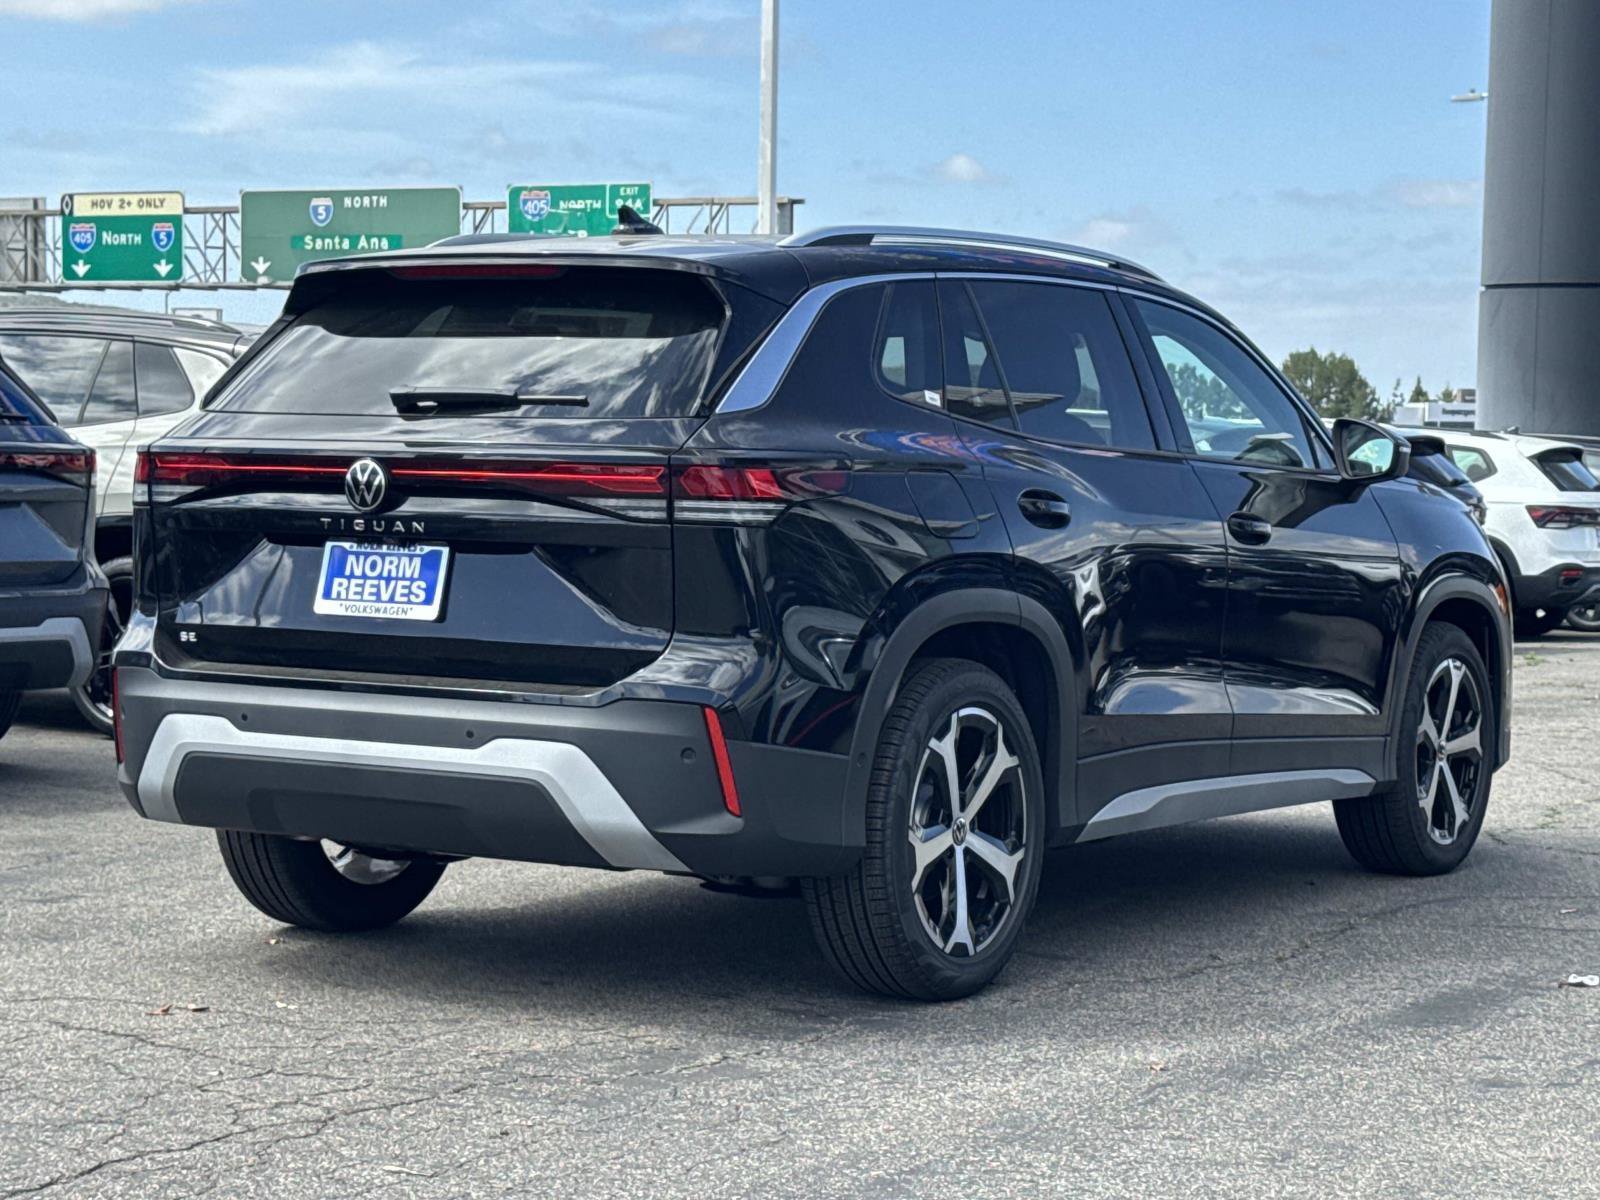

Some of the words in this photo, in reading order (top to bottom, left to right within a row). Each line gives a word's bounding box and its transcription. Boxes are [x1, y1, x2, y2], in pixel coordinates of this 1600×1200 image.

[620, 186, 639, 195] EXIT
[91, 198, 113, 209] HOV
[138, 197, 166, 208] ONLY
[317, 206, 327, 220] 5
[344, 195, 388, 208] NORTH
[525, 200, 547, 214] 405
[74, 231, 92, 244] 405
[159, 231, 167, 246] 5
[304, 235, 350, 250] Santa
[357, 234, 389, 249] Ana
[320, 517, 425, 533] TIGUAN
[344, 554, 422, 578] NORM
[331, 577, 427, 603] REEVES
[180, 631, 197, 642] SE
